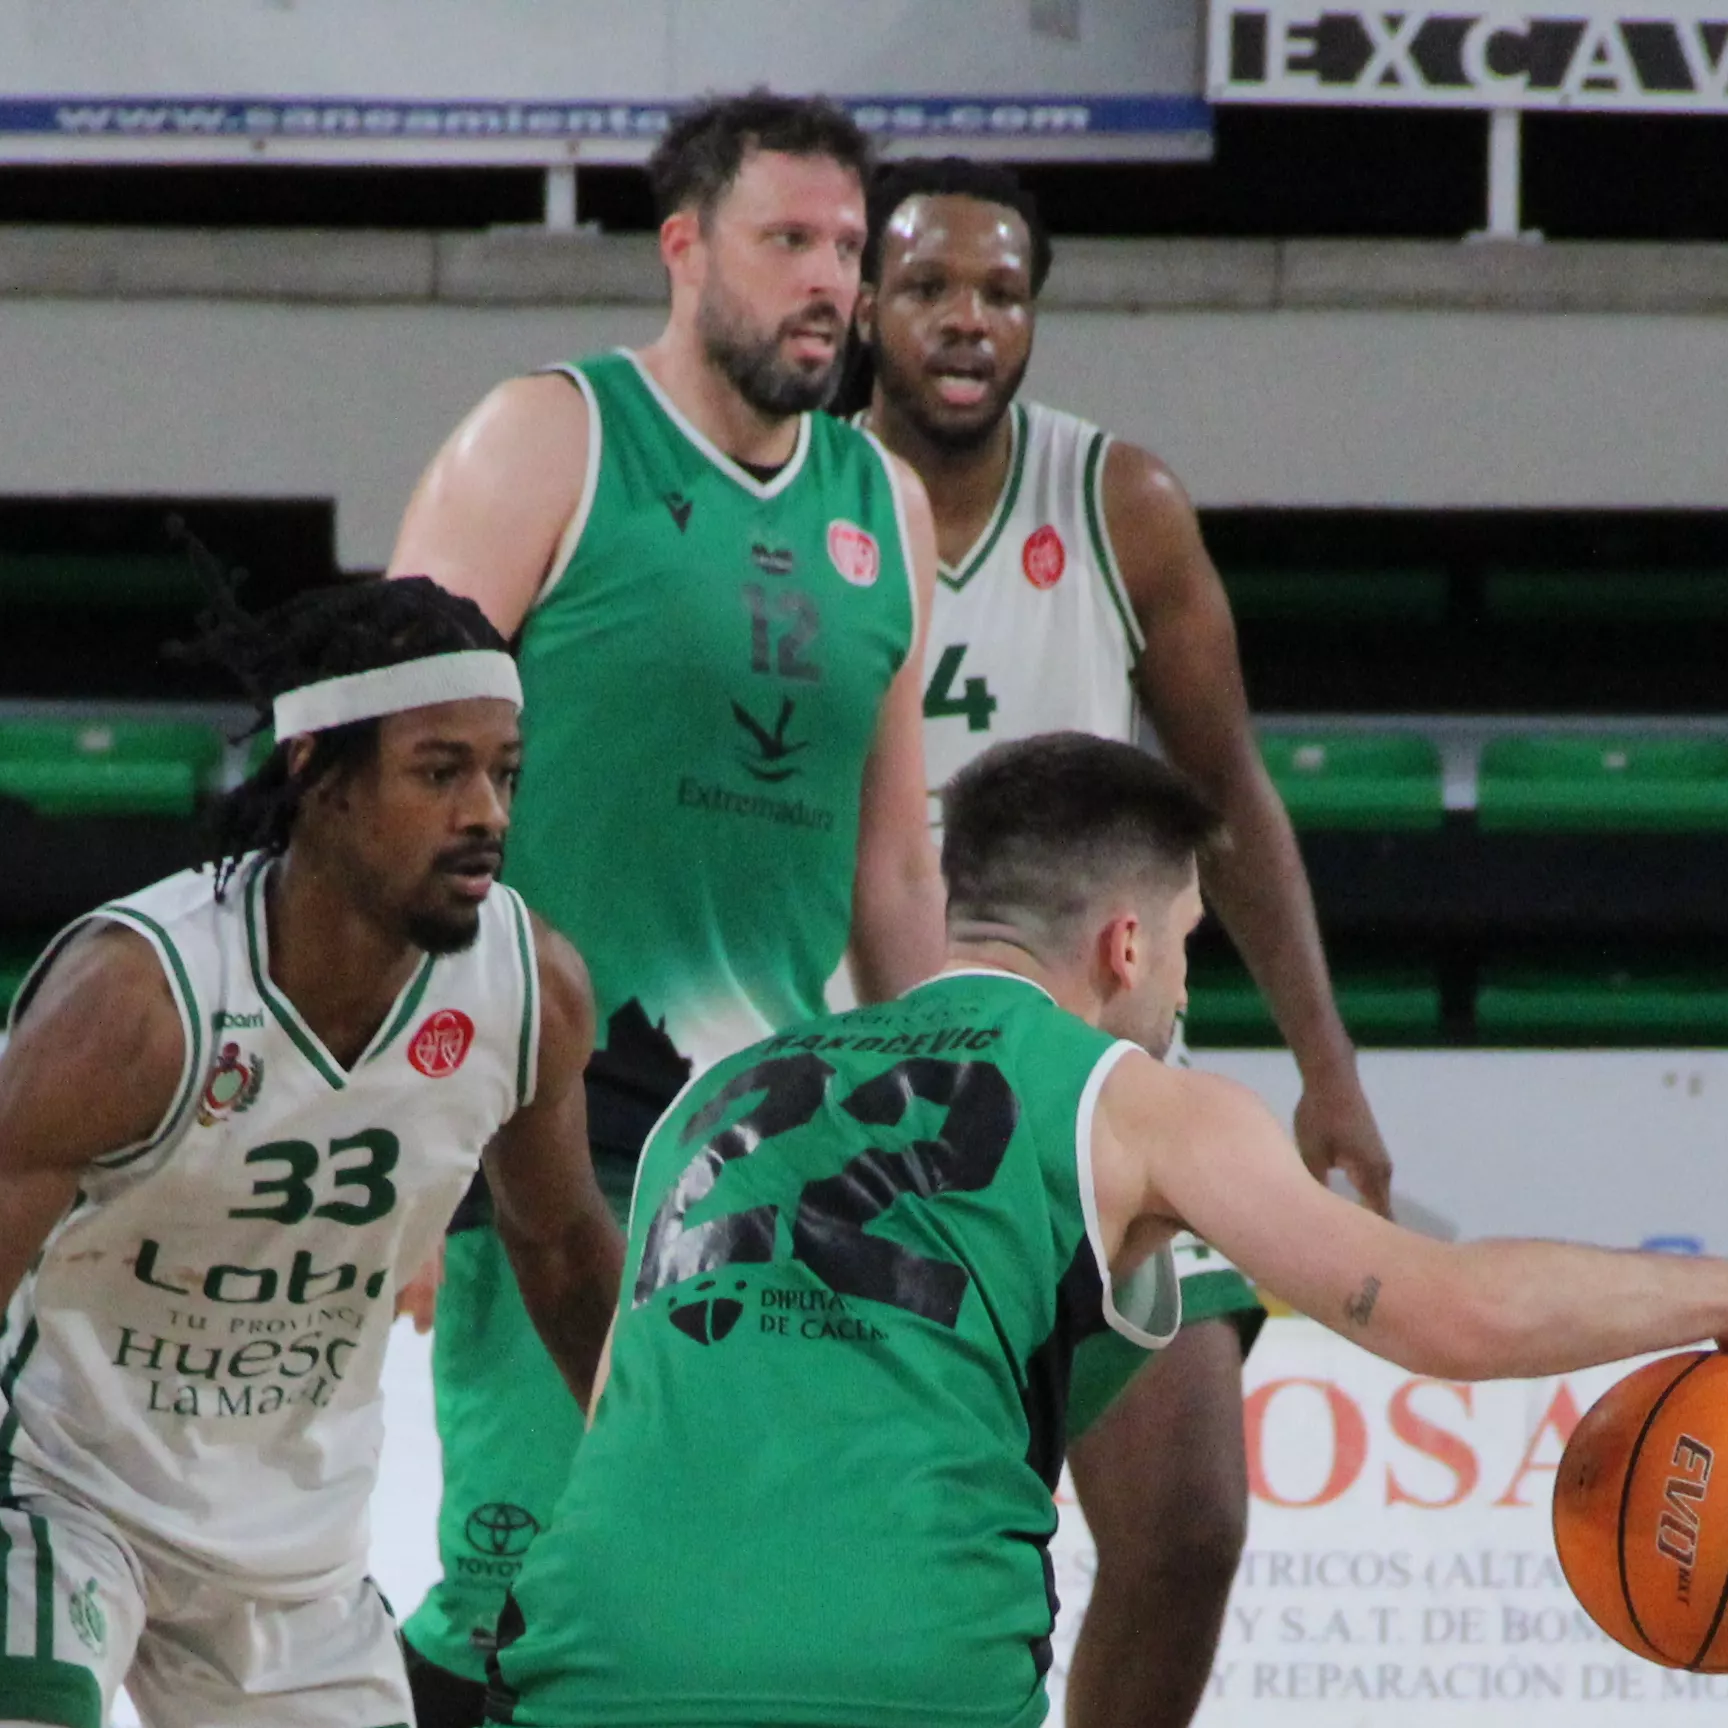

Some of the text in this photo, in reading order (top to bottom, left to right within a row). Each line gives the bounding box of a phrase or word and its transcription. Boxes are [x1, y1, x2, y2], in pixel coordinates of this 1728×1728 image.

[743, 585, 822, 683] 12
[228, 1127, 400, 1226] 33
[761, 1288, 846, 1312] DIPUTA
[760, 1313, 789, 1336] DE
[111, 1326, 358, 1380] Huesc
[1656, 1432, 1715, 1568] EVO
[1242, 1549, 1413, 1590] TRICOS
[1233, 1606, 1265, 1646] Y
[1280, 1606, 1404, 1646] S.A.T.
[1422, 1607, 1490, 1646] DE
[1253, 1655, 1564, 1702] REPARACIÓN
[1580, 1664, 1648, 1703] DE
